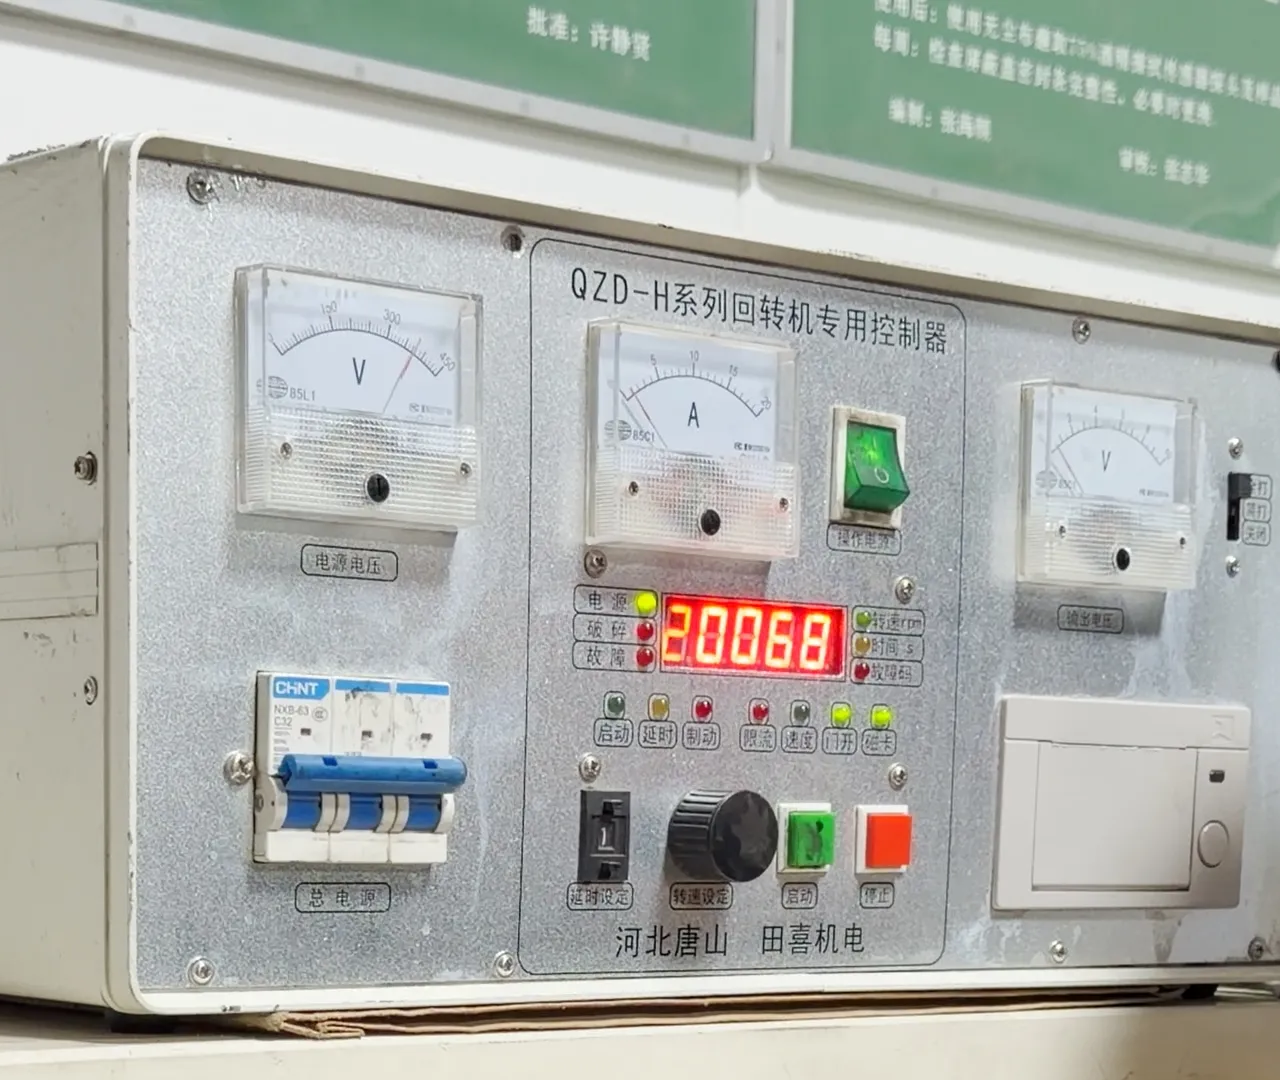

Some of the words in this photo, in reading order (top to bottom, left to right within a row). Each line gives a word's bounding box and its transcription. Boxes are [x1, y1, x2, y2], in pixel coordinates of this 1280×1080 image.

[383, 309, 401, 325] 300
[571, 267, 948, 354] QZD-H系列回转机专用控制器
[439, 352, 456, 372] 450
[650, 354, 657, 366] 5
[690, 350, 700, 362] 10
[352, 357, 366, 385] V
[729, 364, 739, 377] 15
[687, 402, 700, 428] A
[1101, 450, 1112, 472] V
[315, 552, 384, 576] 电源电压
[588, 590, 628, 612] 电源
[664, 604, 832, 671] 20068
[872, 637, 898, 656] 时间
[587, 645, 625, 667] 故障
[870, 662, 912, 682] 故障码
[598, 723, 630, 743] 启动
[642, 724, 673, 745] 延时
[686, 727, 717, 746] 制动
[743, 728, 773, 749] 限流
[785, 730, 813, 750] 速度
[825, 732, 853, 751] 门开
[309, 888, 375, 908] 总电源
[570, 887, 629, 906] 延时设定
[673, 887, 730, 906] 转速设定
[786, 886, 814, 905] 启动
[864, 886, 890, 904] 停止
[616, 924, 728, 958] 河北唐山
[762, 922, 865, 955] 田喜机电
